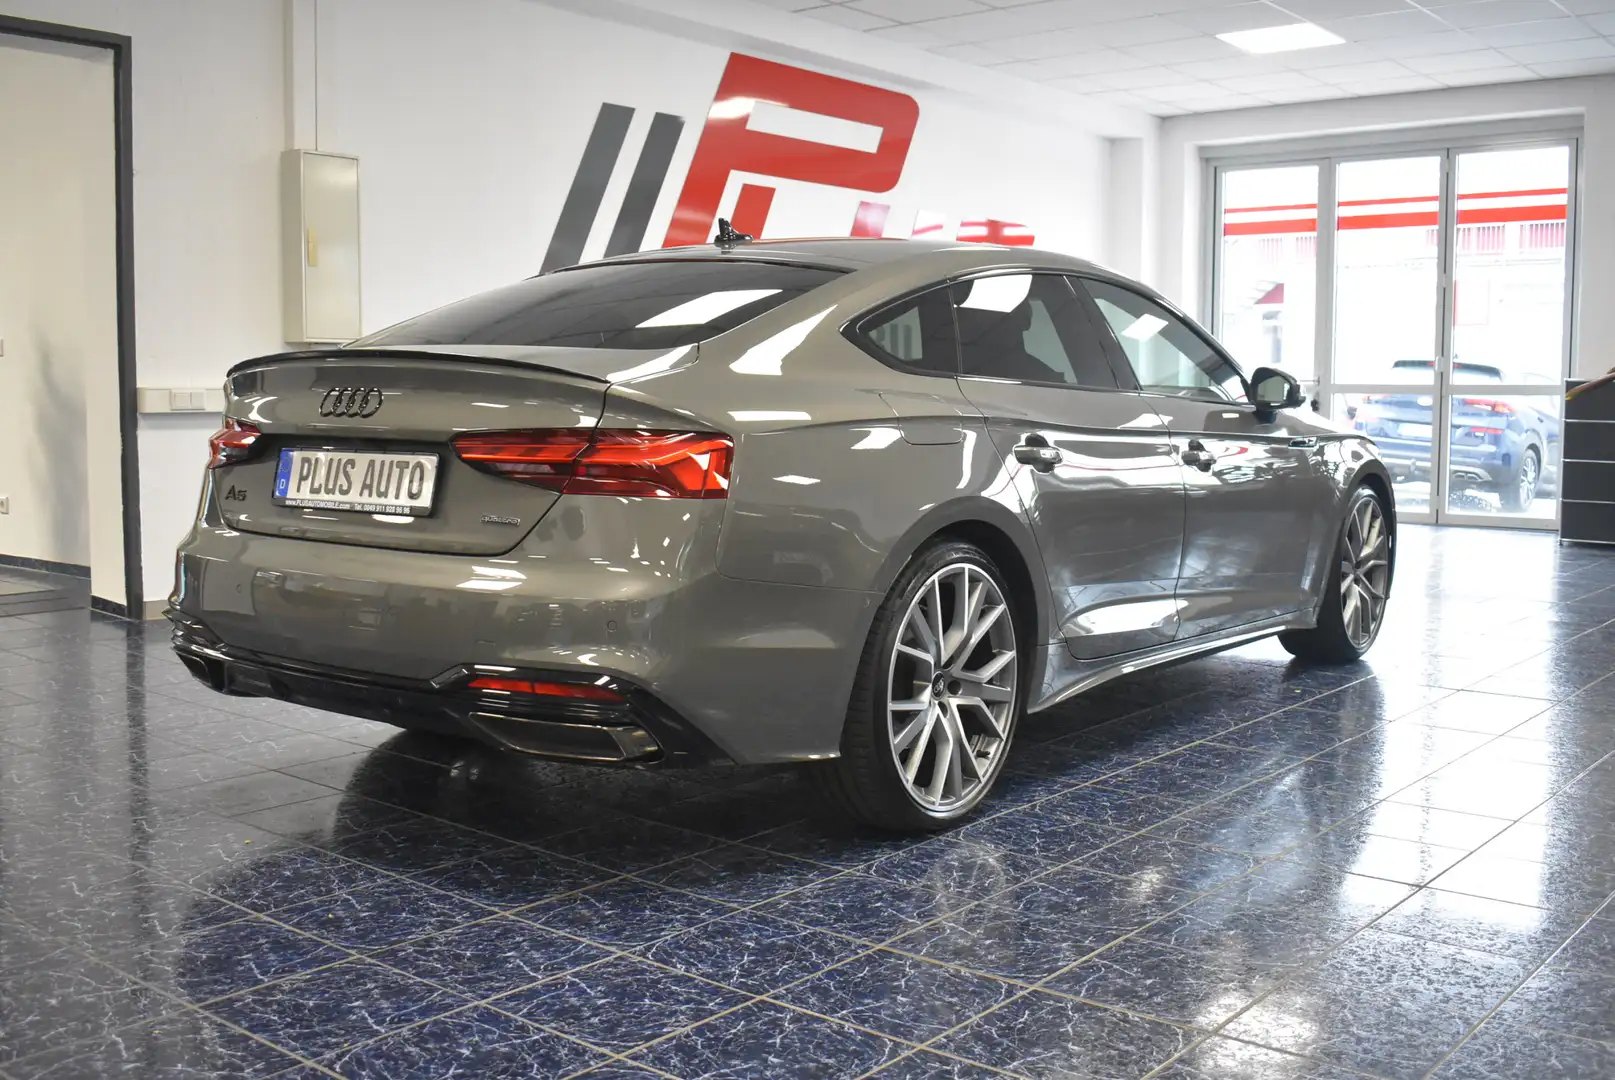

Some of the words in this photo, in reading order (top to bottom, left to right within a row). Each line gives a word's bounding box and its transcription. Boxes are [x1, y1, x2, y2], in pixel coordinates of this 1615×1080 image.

[225, 484, 247, 501] A5
[296, 456, 356, 496] PLUS
[359, 459, 425, 500] AUTO
